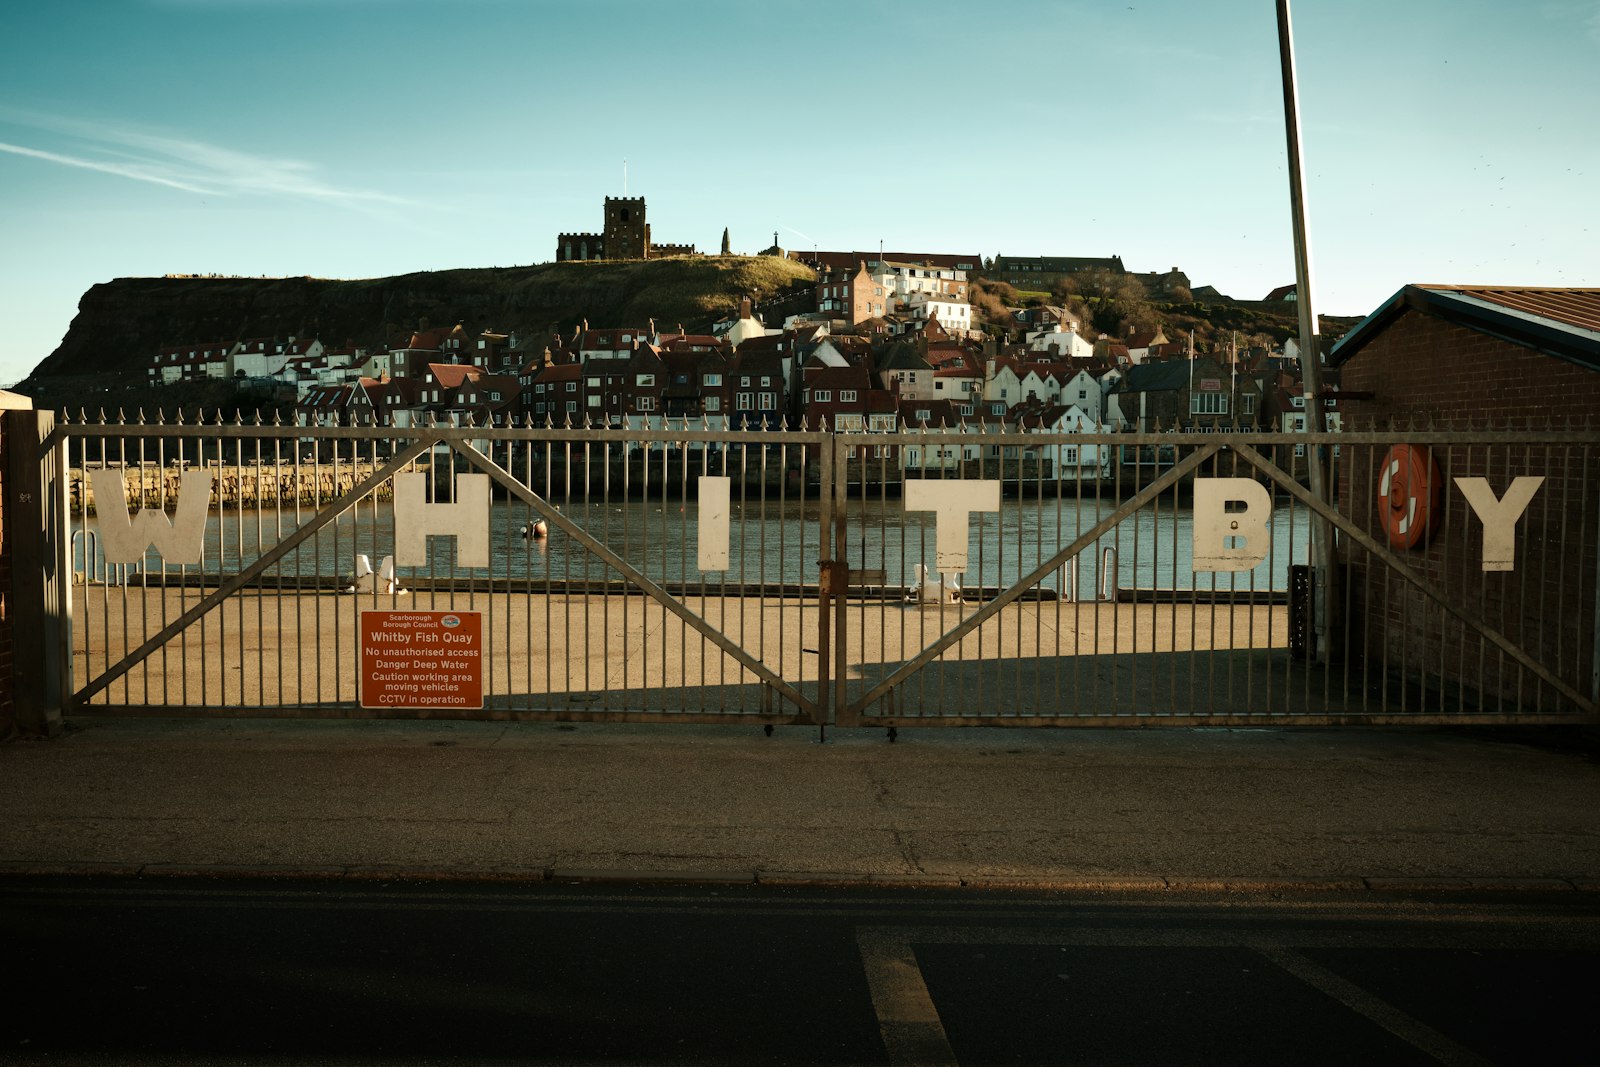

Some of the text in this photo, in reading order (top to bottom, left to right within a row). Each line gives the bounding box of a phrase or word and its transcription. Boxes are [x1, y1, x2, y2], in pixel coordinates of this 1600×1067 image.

[89, 469, 1545, 573] WHITBY
[389, 614, 432, 622] Scarborough
[383, 621, 411, 629] Borough
[371, 632, 473, 645] Whitby Fish Quay
[366, 647, 479, 657] No unauthorised access
[376, 660, 469, 670] Danger Deep Water
[372, 672, 409, 681] Caution
[412, 673, 449, 682] working
[385, 683, 459, 692] moving vehicles
[379, 694, 406, 703] CCTV
[420, 695, 465, 704] operation
